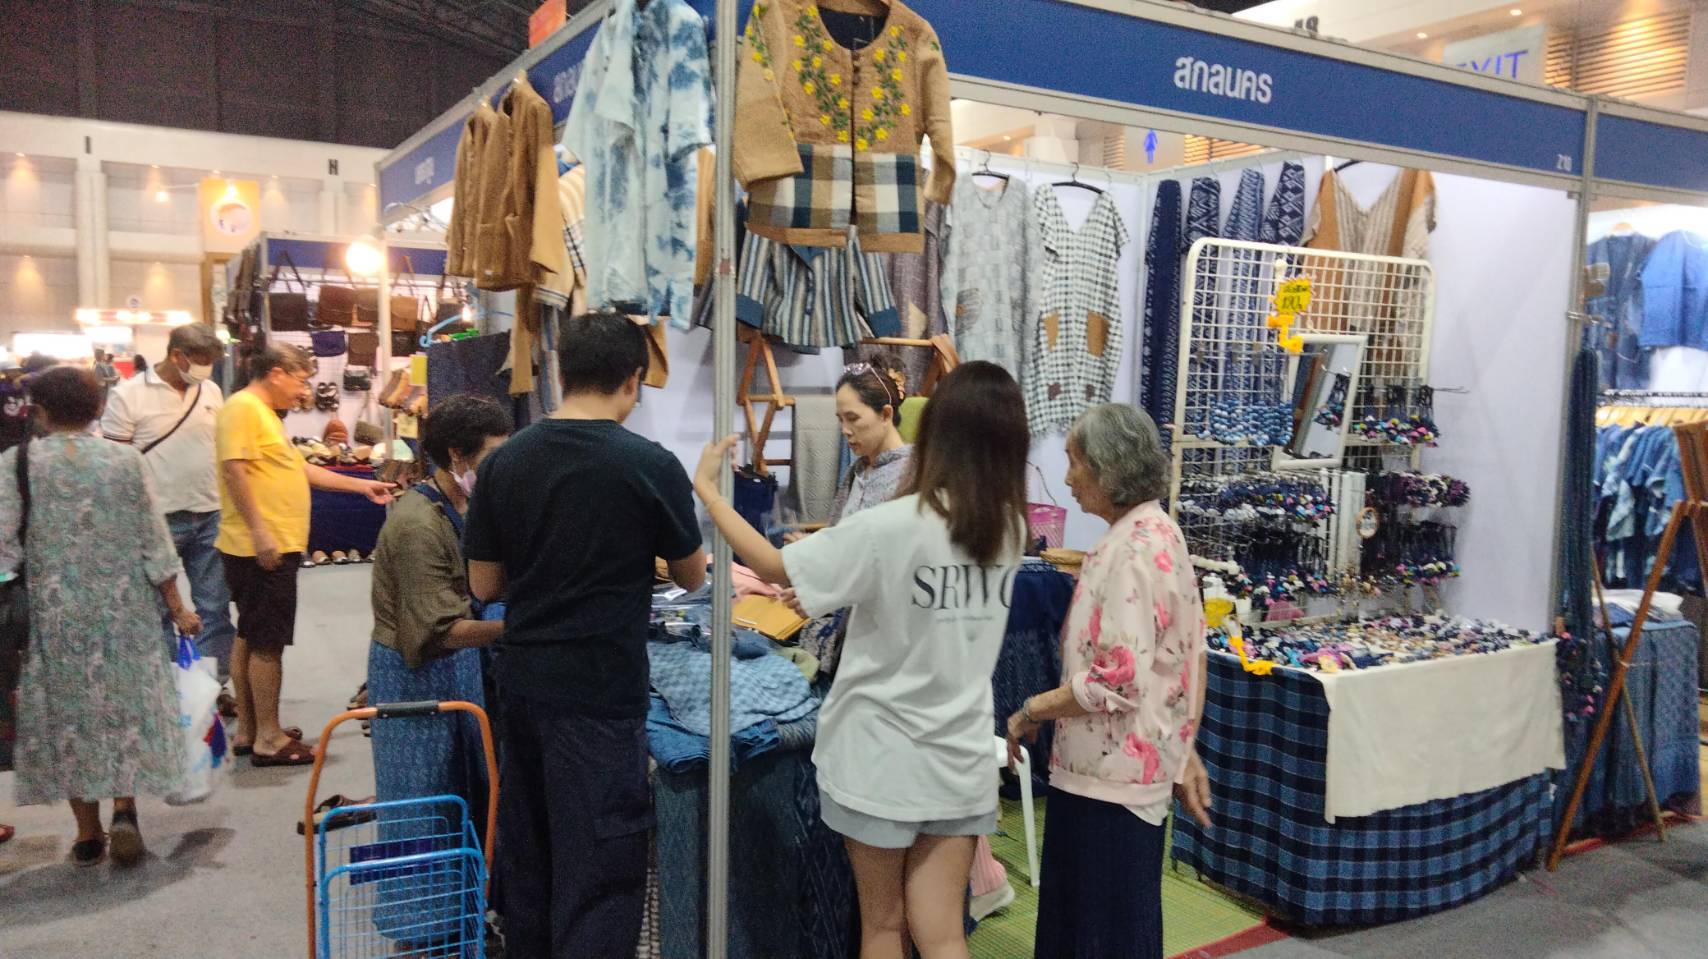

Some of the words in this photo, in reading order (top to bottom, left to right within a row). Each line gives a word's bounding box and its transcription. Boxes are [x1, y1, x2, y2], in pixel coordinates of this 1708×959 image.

[1173, 56, 1273, 104] สกลนคร
[1456, 49, 1528, 78] IT
